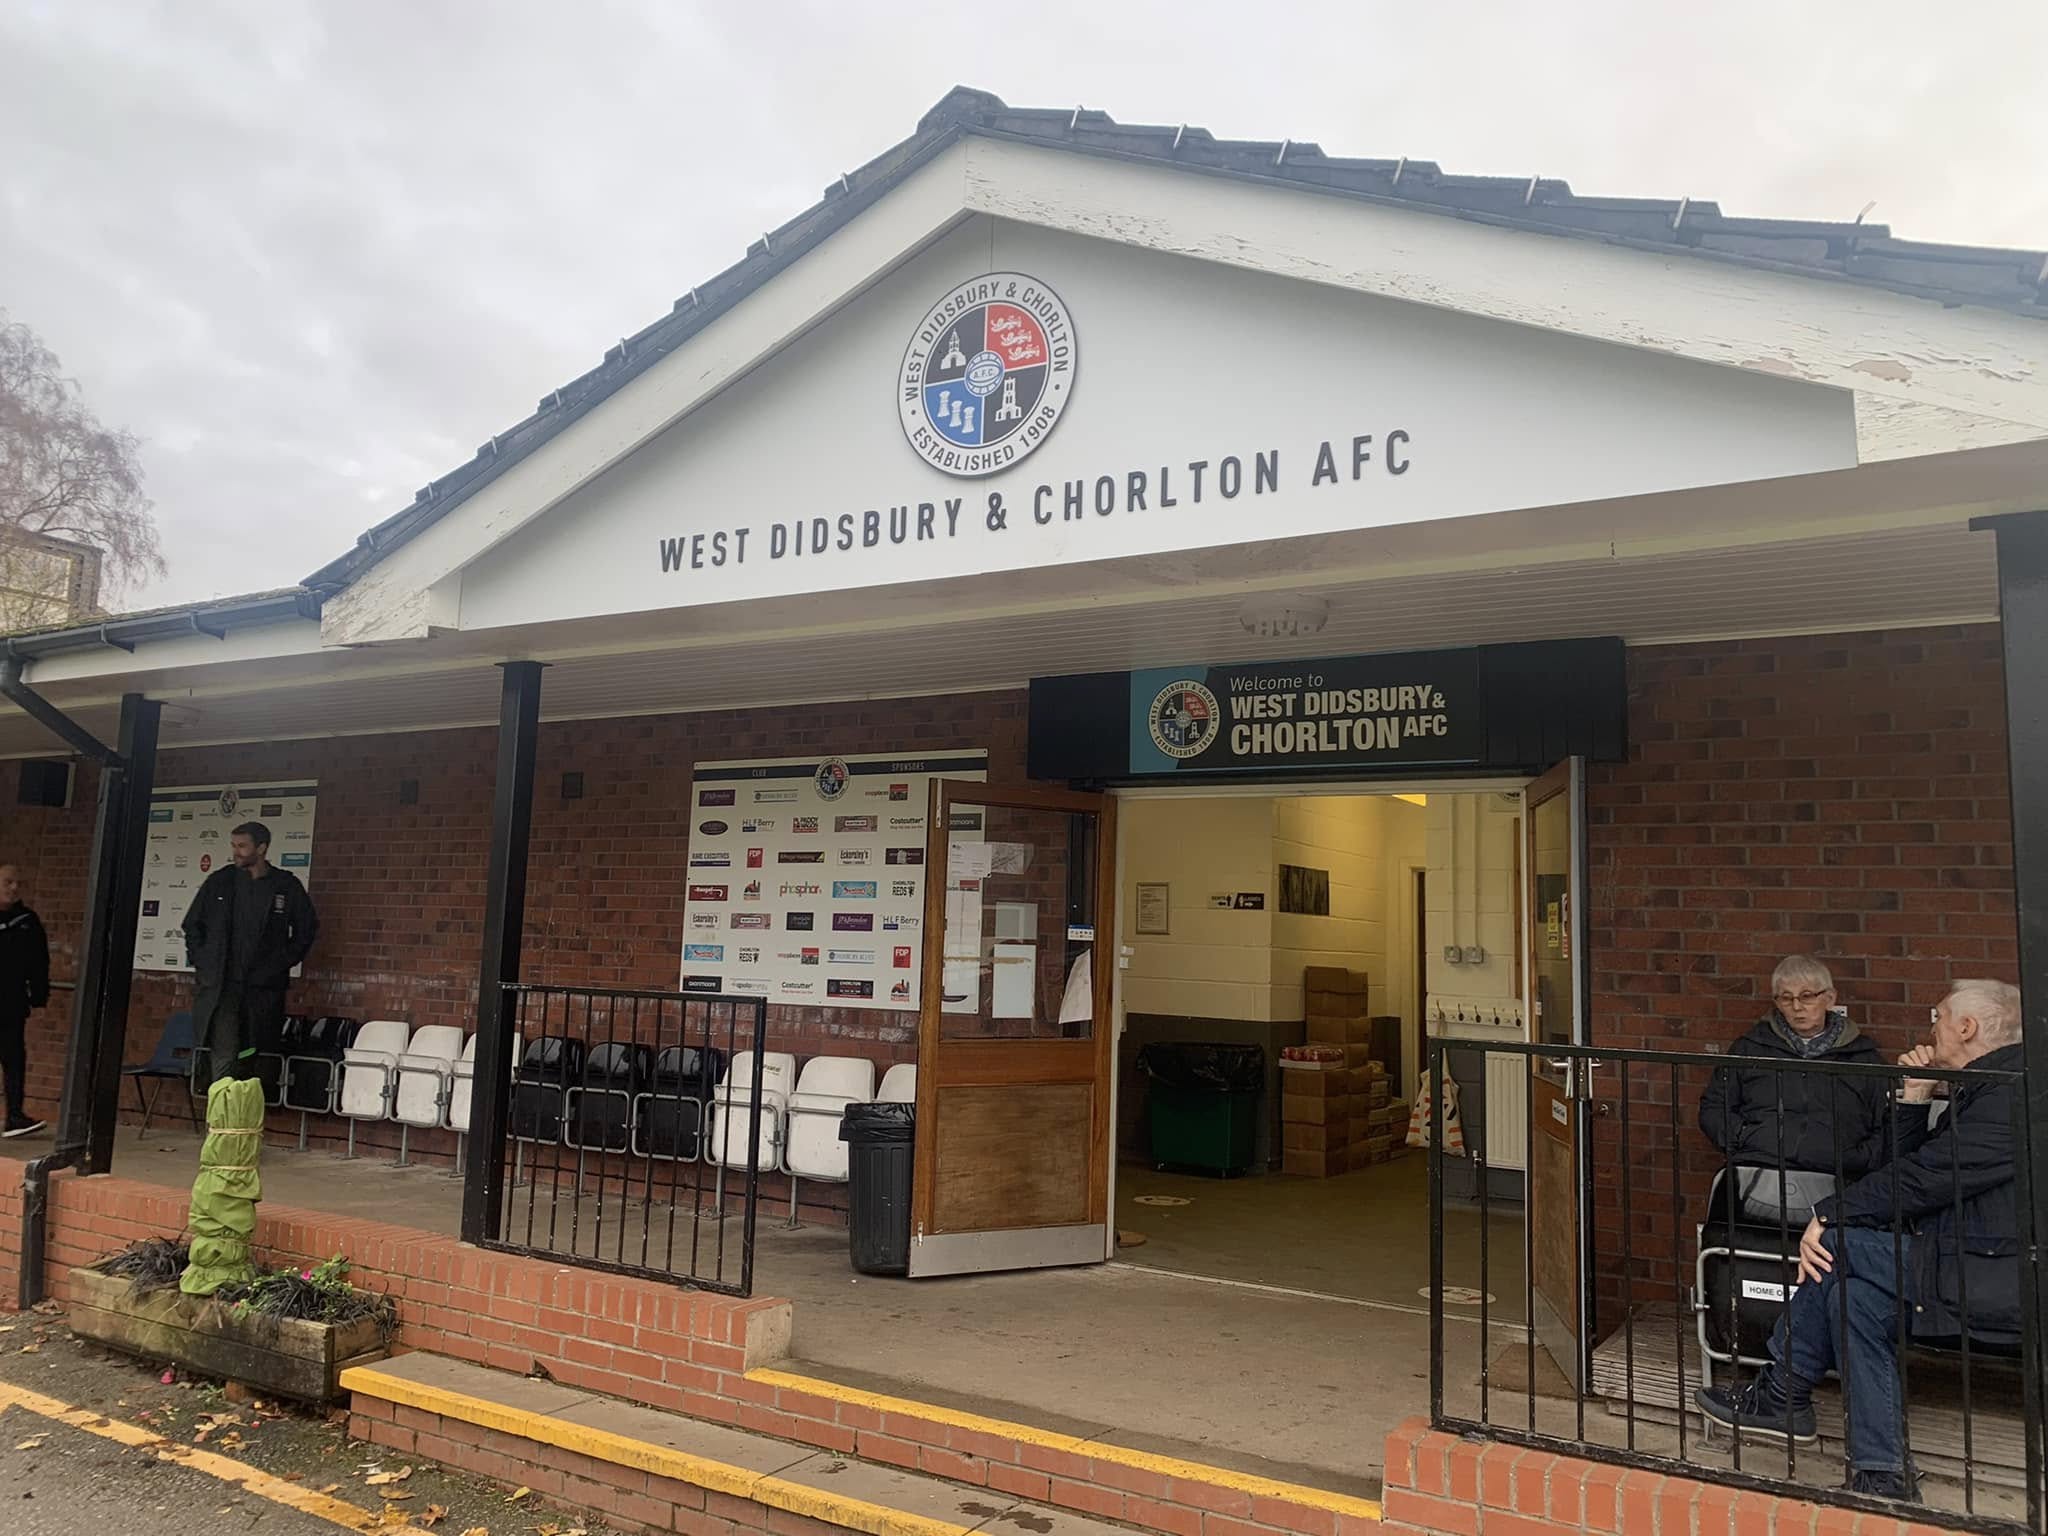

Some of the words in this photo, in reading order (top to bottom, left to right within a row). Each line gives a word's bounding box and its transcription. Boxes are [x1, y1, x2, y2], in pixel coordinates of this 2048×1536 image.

[905, 348, 925, 402] WEST
[921, 281, 1000, 344] DIDSBURY
[1005, 281, 1017, 298] &
[1022, 287, 1069, 372] CHORLTON
[913, 426, 1015, 471] ESTABLISHED
[1019, 405, 1055, 448] 1908
[660, 528, 751, 574] WEST
[769, 497, 963, 560] DIDSBURY
[986, 492, 1008, 532] &
[1033, 449, 1281, 527] CHORLTON
[1311, 428, 1412, 487] AFC
[1230, 676, 1303, 692] Welcome
[1307, 673, 1324, 687] to
[1230, 692, 1297, 719] WEST
[1231, 716, 1400, 755] CHORLTON
[1403, 714, 1448, 737] AFC
[1749, 1286, 1775, 1296] HOME
